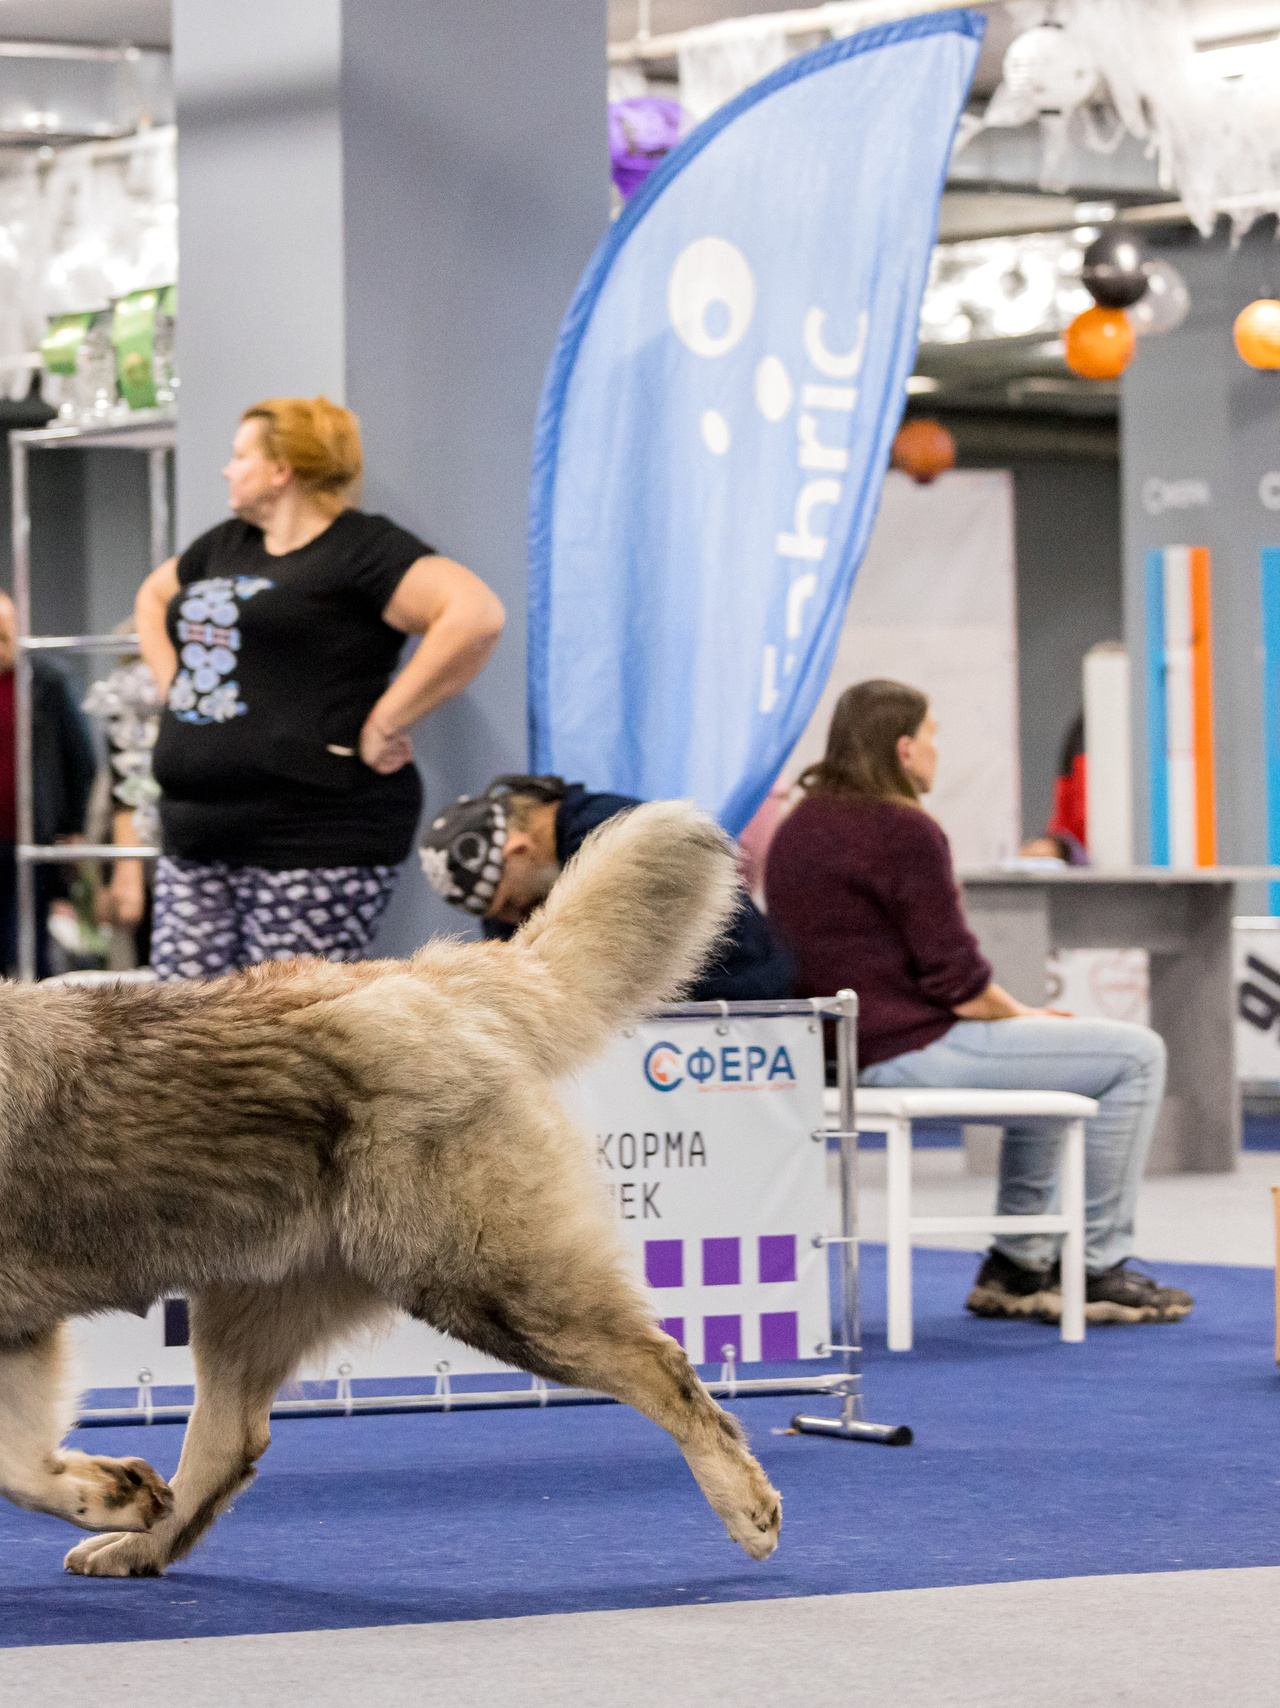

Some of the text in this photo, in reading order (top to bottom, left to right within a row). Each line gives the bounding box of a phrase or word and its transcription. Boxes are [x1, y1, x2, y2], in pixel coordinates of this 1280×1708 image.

[644, 1041, 797, 1092] СФЕРА
[596, 1131, 706, 1169] КОРМА
[609, 1182, 662, 1219] ЕК
